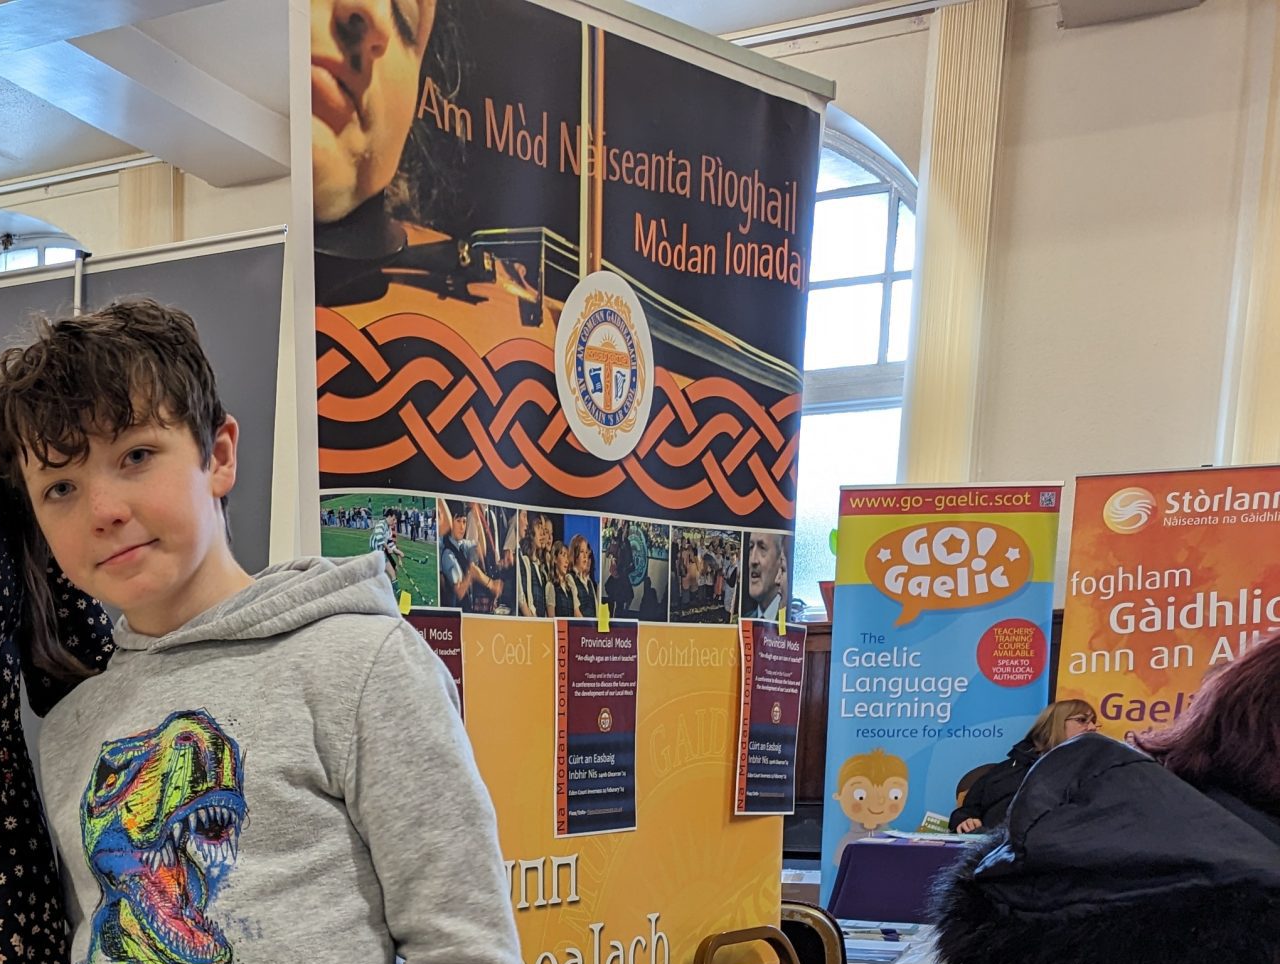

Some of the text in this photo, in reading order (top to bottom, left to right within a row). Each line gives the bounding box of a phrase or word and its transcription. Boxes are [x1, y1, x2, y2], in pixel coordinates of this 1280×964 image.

[418, 77, 472, 141] Am
[484, 97, 548, 168] Mòd
[701, 154, 798, 234] Rìoghail
[635, 211, 717, 276] Mòdan
[850, 491, 1031, 511] www.go-gaelic.scot
[1163, 514, 1237, 527] Nàiseanta na
[902, 526, 998, 566] GO!
[884, 557, 1010, 599] Gaelic
[1071, 565, 1191, 600] foghlam
[430, 628, 453, 640] Mods
[581, 637, 632, 648] Provincial Mods
[860, 633, 885, 644] The
[995, 635, 1033, 643] TRAINING
[763, 636, 800, 651] Provincial Mods
[998, 642, 1031, 650] COURSE
[842, 647, 922, 667] Gaelic
[992, 649, 1035, 657] AVAILABLE
[1068, 644, 1193, 675] ann an
[842, 673, 968, 698] Language
[840, 698, 952, 722] Learning
[856, 725, 1004, 738] resource for schools
[584, 756, 592, 764] an
[569, 770, 587, 780] Inbhir
[588, 769, 598, 779] Nis
[557, 807, 566, 832] Na
